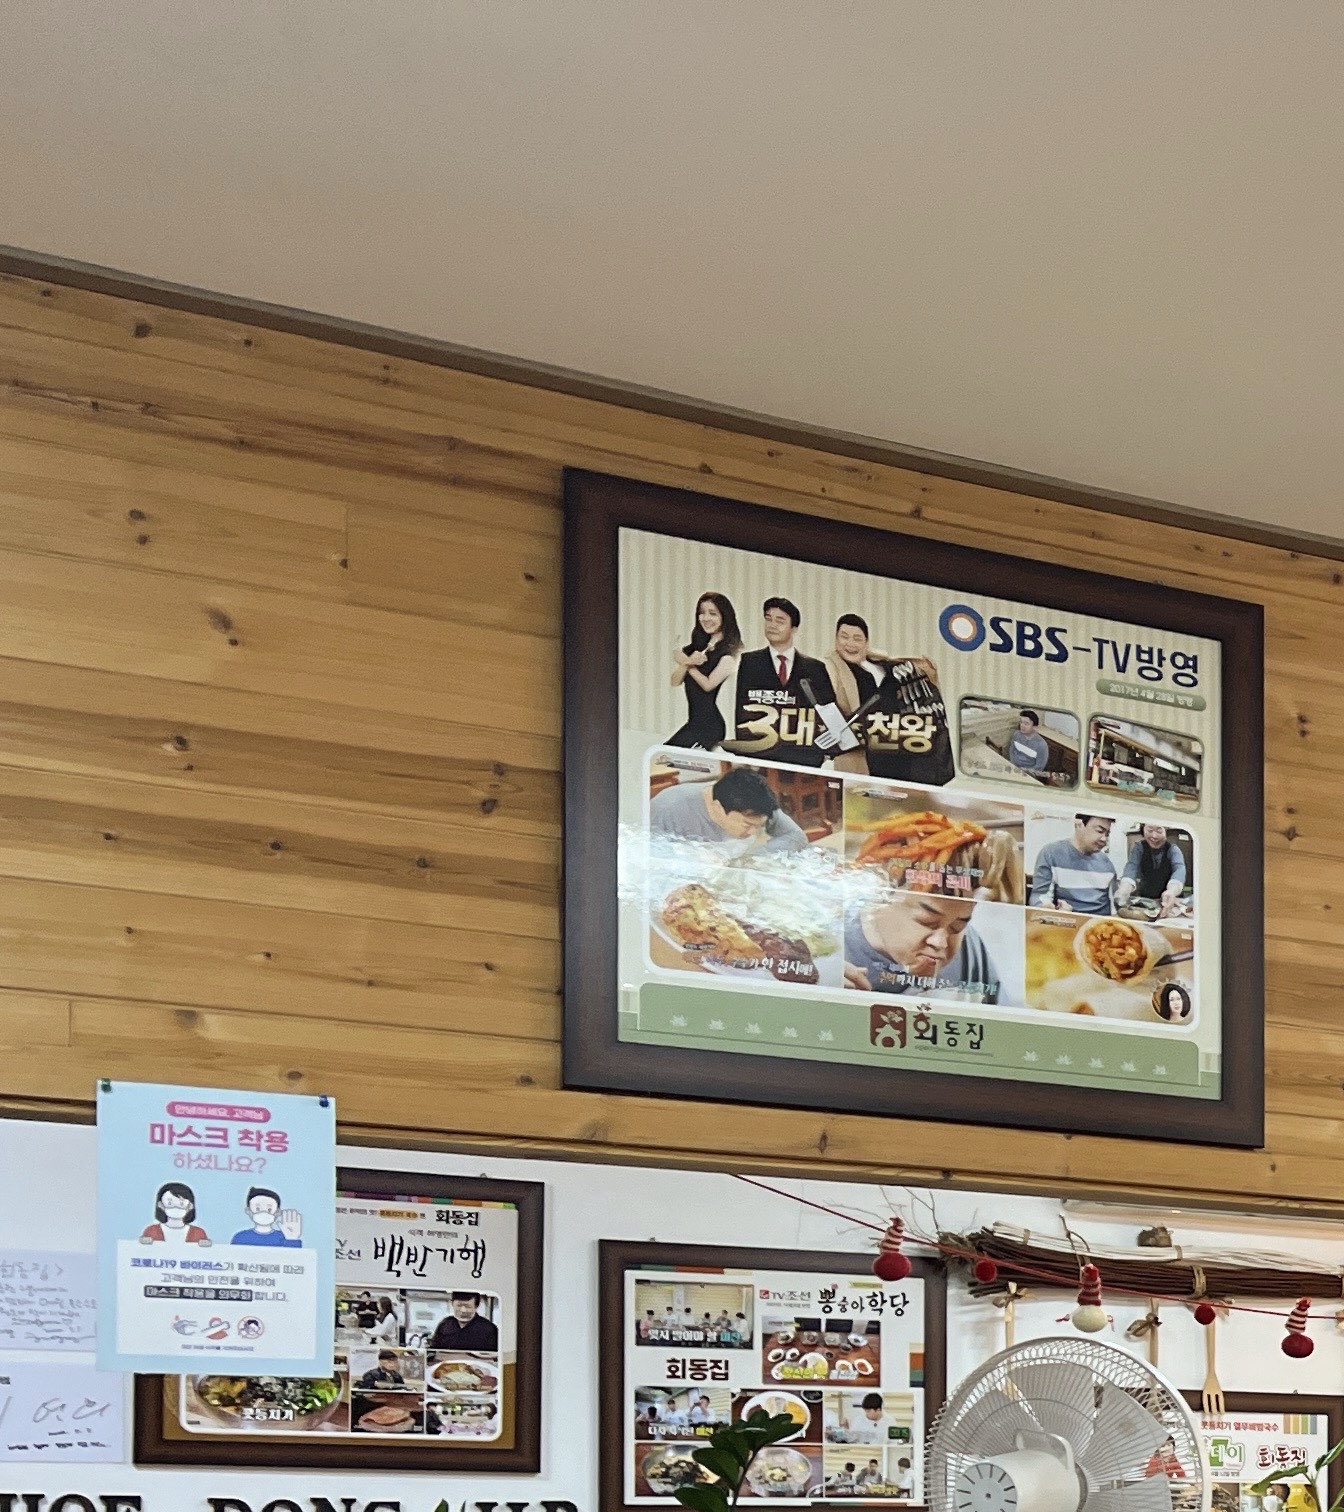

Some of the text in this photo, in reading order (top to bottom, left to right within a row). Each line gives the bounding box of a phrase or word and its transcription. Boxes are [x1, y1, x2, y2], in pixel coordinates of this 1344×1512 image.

[737, 704, 937, 753] 3대 천왕
[913, 1004, 985, 1051] 회동집
[149, 1122, 290, 1154] 마스크 착용
[172, 1152, 268, 1174] 하셨나요?
[435, 1209, 480, 1227] 회동집
[373, 1234, 487, 1279] 백반기행
[666, 1358, 729, 1381] 회동집
[1259, 1446, 1307, 1469] 회동집
